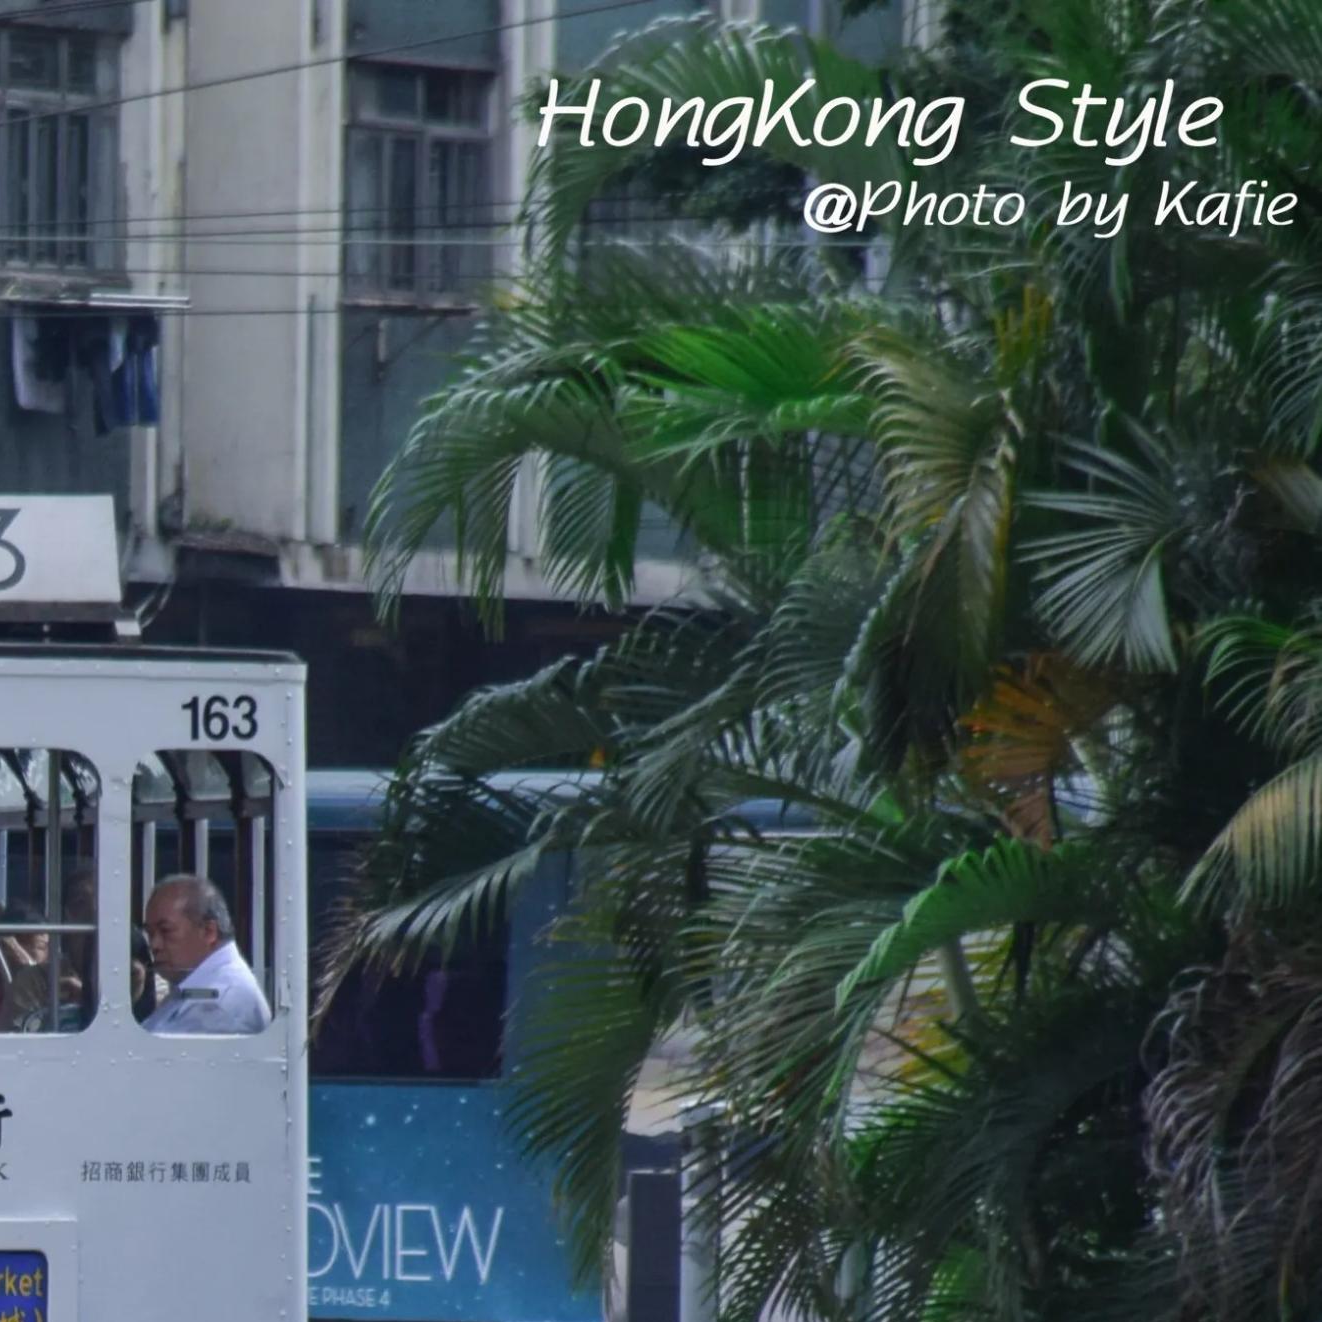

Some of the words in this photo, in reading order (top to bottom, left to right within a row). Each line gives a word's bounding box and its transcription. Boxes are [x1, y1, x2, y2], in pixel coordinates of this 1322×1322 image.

[181, 695, 258, 741] 163
[80, 1160, 252, 1184] 招商銀行集團成員
[322, 1287, 376, 1307] PHASE
[379, 1288, 390, 1307] 4
